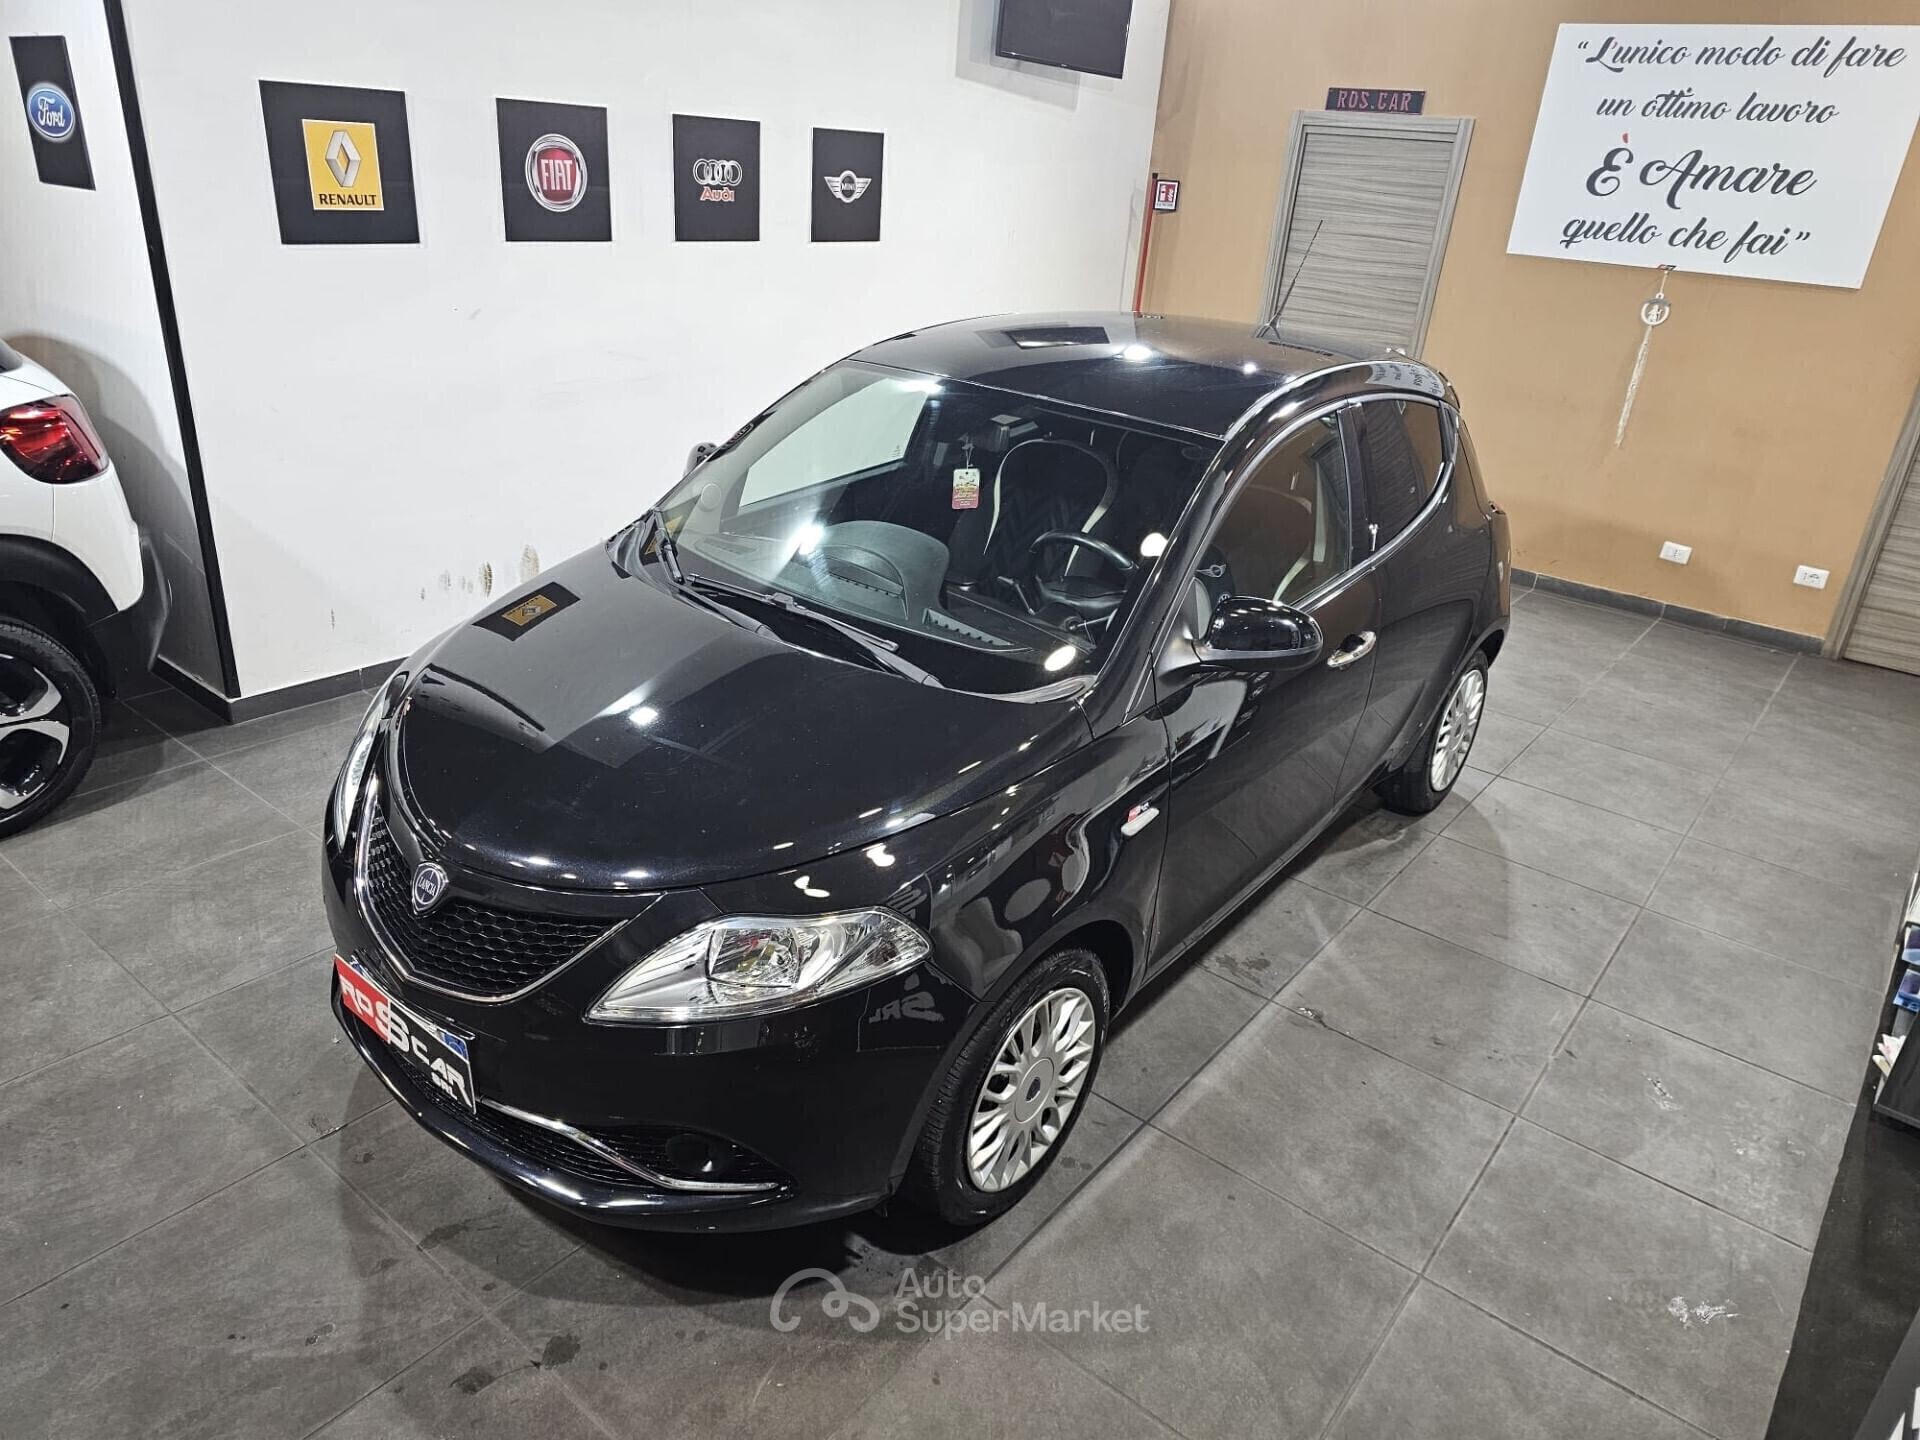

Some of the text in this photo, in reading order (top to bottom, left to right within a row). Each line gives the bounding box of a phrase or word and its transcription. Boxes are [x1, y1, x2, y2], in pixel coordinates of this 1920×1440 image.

[1695, 36, 1786, 66] modo
[1790, 36, 1829, 66] di
[1823, 37, 1907, 78] fare
[37, 97, 66, 128] Ford
[1596, 87, 1840, 124] un ottimo lavoro
[541, 159, 574, 191] FIAT
[840, 181, 857, 192] MINI
[1585, 132, 1818, 210] È Amare
[318, 192, 377, 208] RENAULT
[700, 186, 735, 202] Audi
[1559, 212, 1662, 249] quello
[1668, 217, 1729, 249] che
[417, 876, 437, 897] LANCIA
